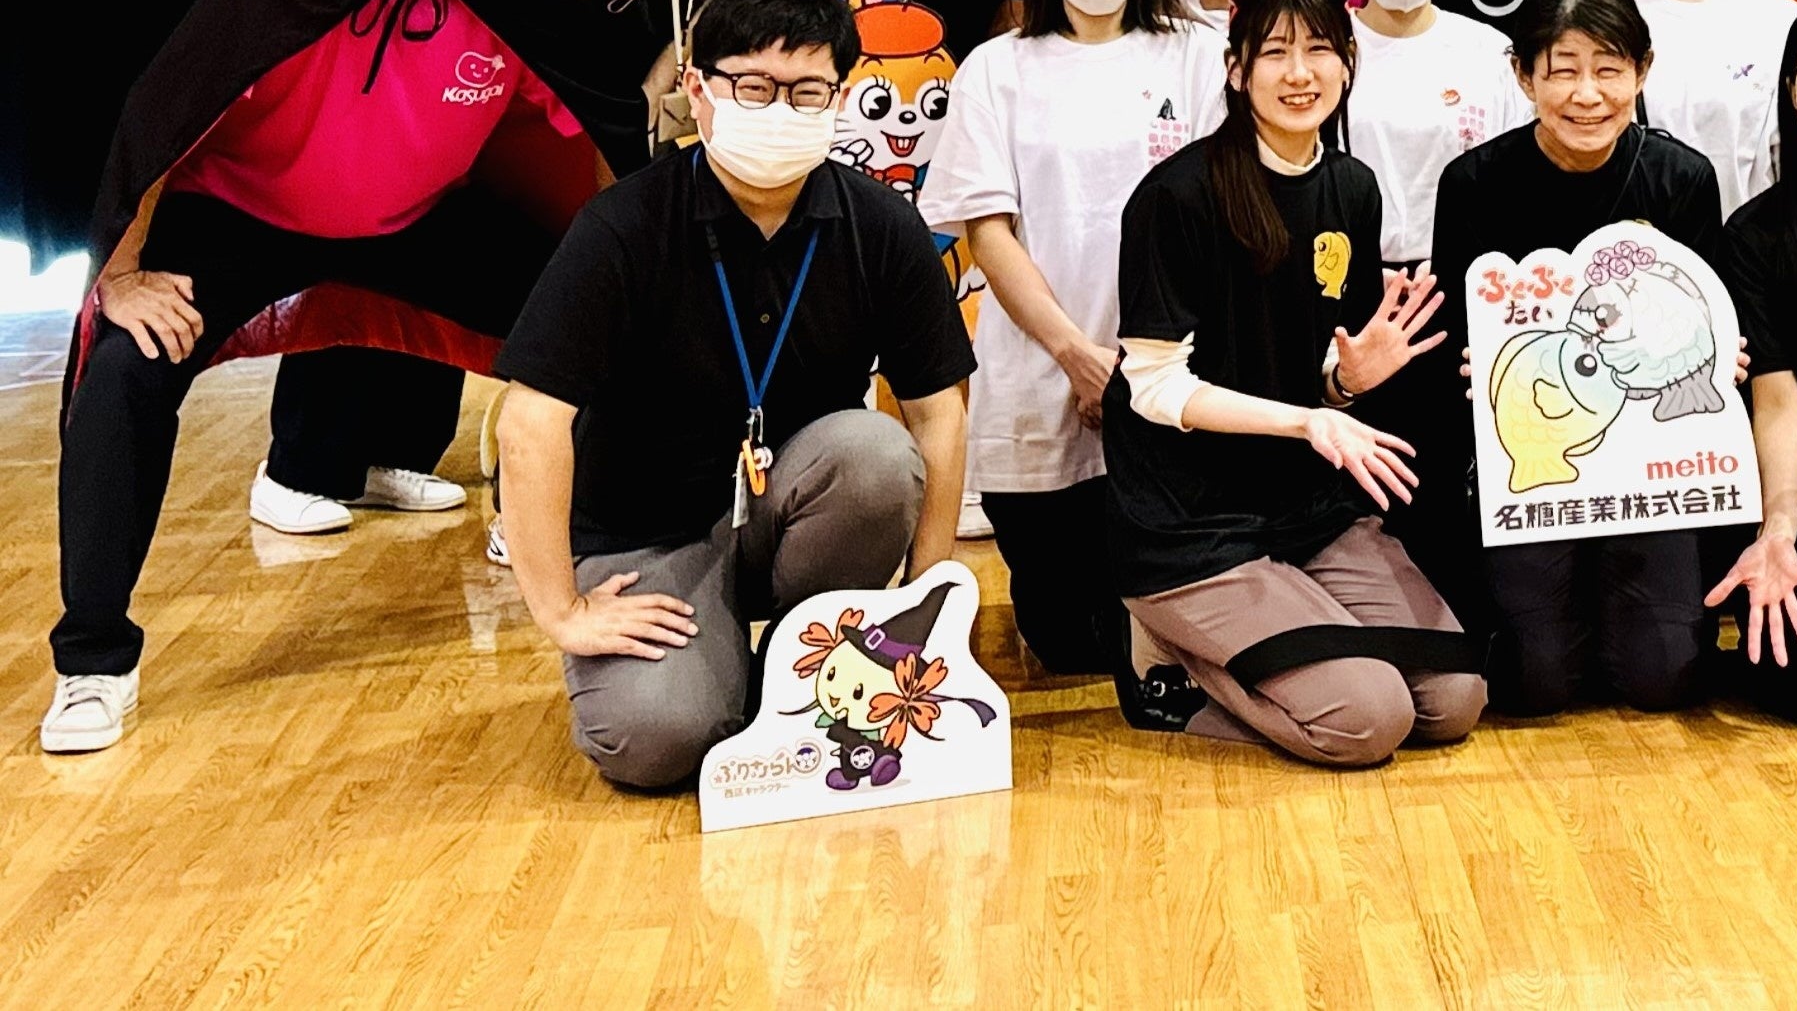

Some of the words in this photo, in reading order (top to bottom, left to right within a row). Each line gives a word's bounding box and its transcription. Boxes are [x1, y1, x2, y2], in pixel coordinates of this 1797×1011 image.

[441, 83, 505, 106] Kasugai
[1503, 299, 1554, 325] たい
[1646, 451, 1739, 481] meito
[1493, 484, 1743, 531] 名糖産業株式会社
